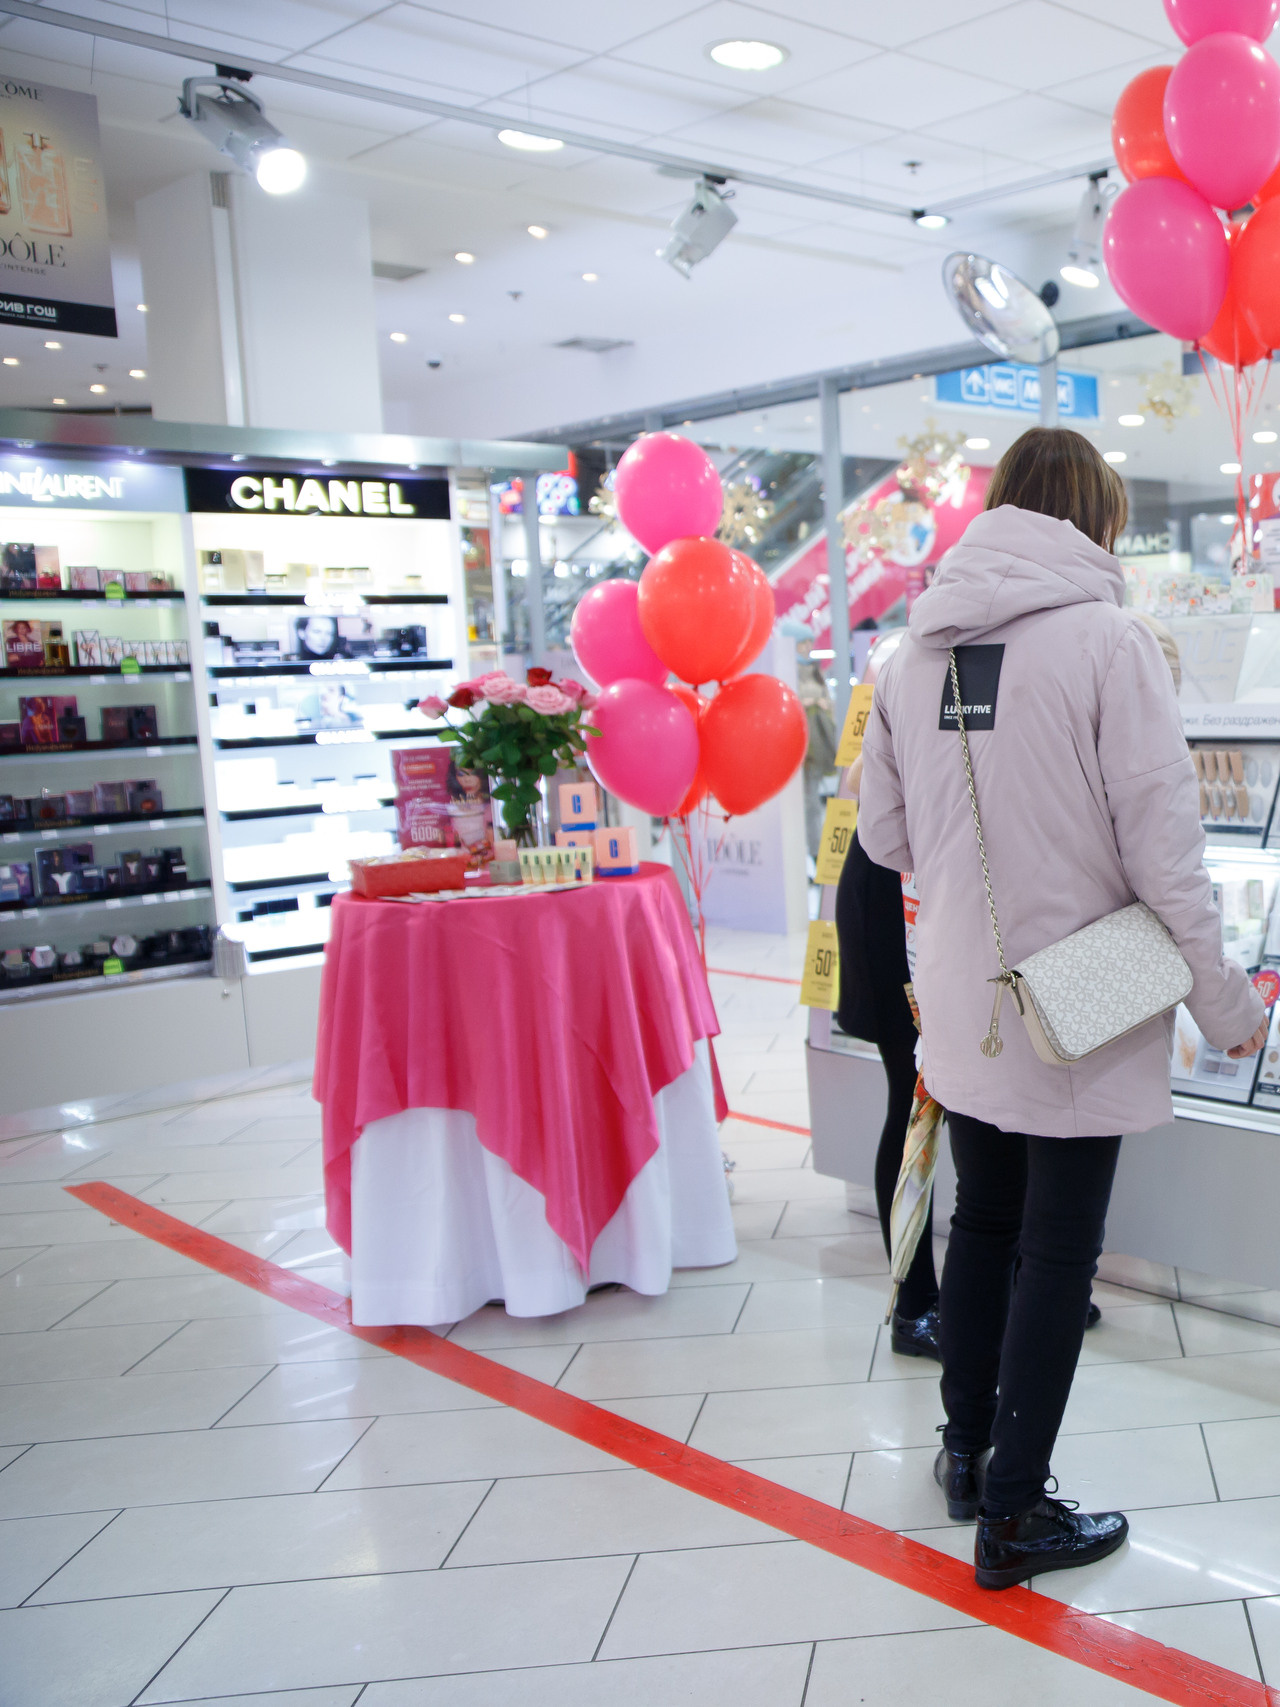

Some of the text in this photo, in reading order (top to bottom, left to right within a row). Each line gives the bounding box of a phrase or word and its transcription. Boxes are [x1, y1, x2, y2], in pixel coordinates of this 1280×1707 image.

[0, 80, 43, 101] ÔME
[26, 304, 56, 318] ГОШ
[230, 476, 415, 514] CHANEL
[6, 641, 42, 653] LIBRE
[944, 704, 992, 715] LUKY FIVE
